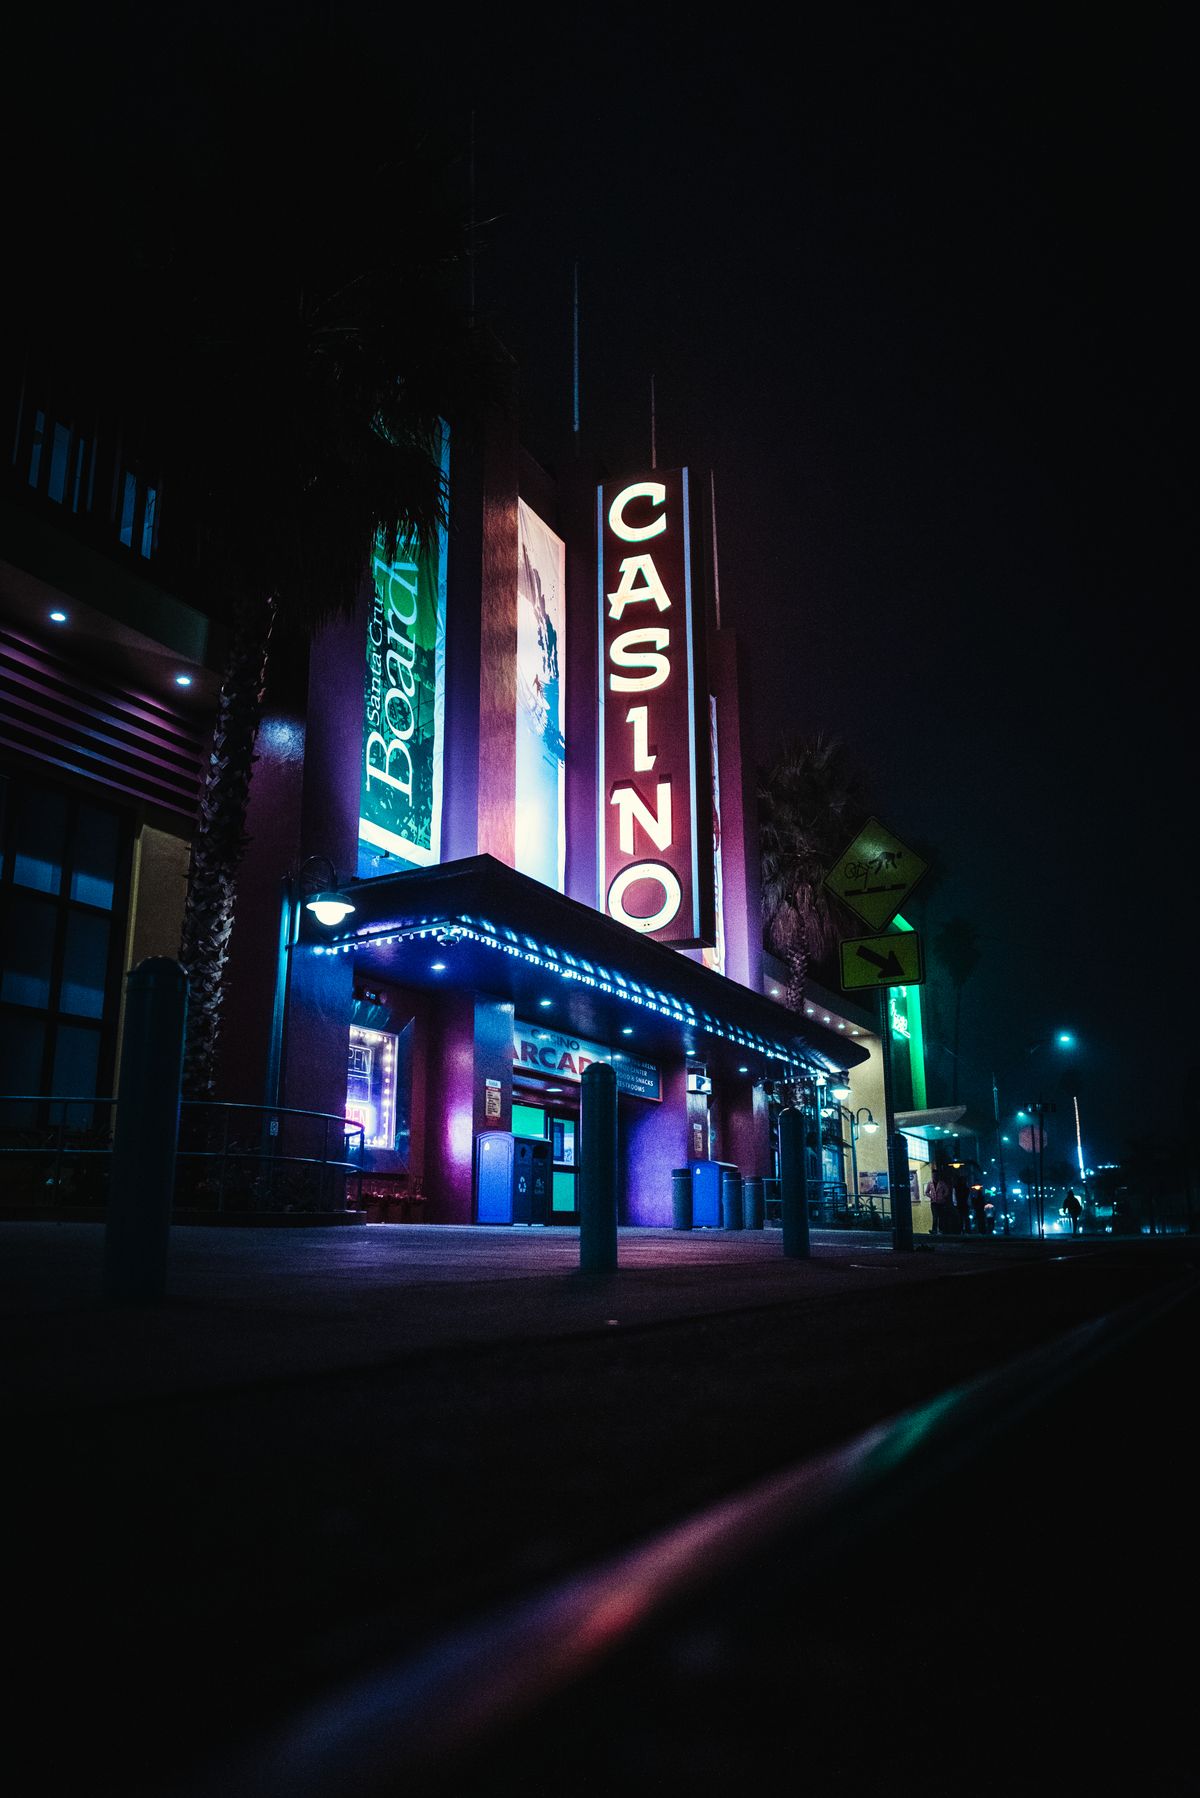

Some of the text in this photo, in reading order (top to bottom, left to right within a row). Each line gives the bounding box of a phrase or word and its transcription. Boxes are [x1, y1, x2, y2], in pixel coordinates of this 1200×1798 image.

[366, 582, 384, 728] Santa Cruz
[607, 481, 682, 935] CASINO
[530, 1028, 580, 1051] CSINO
